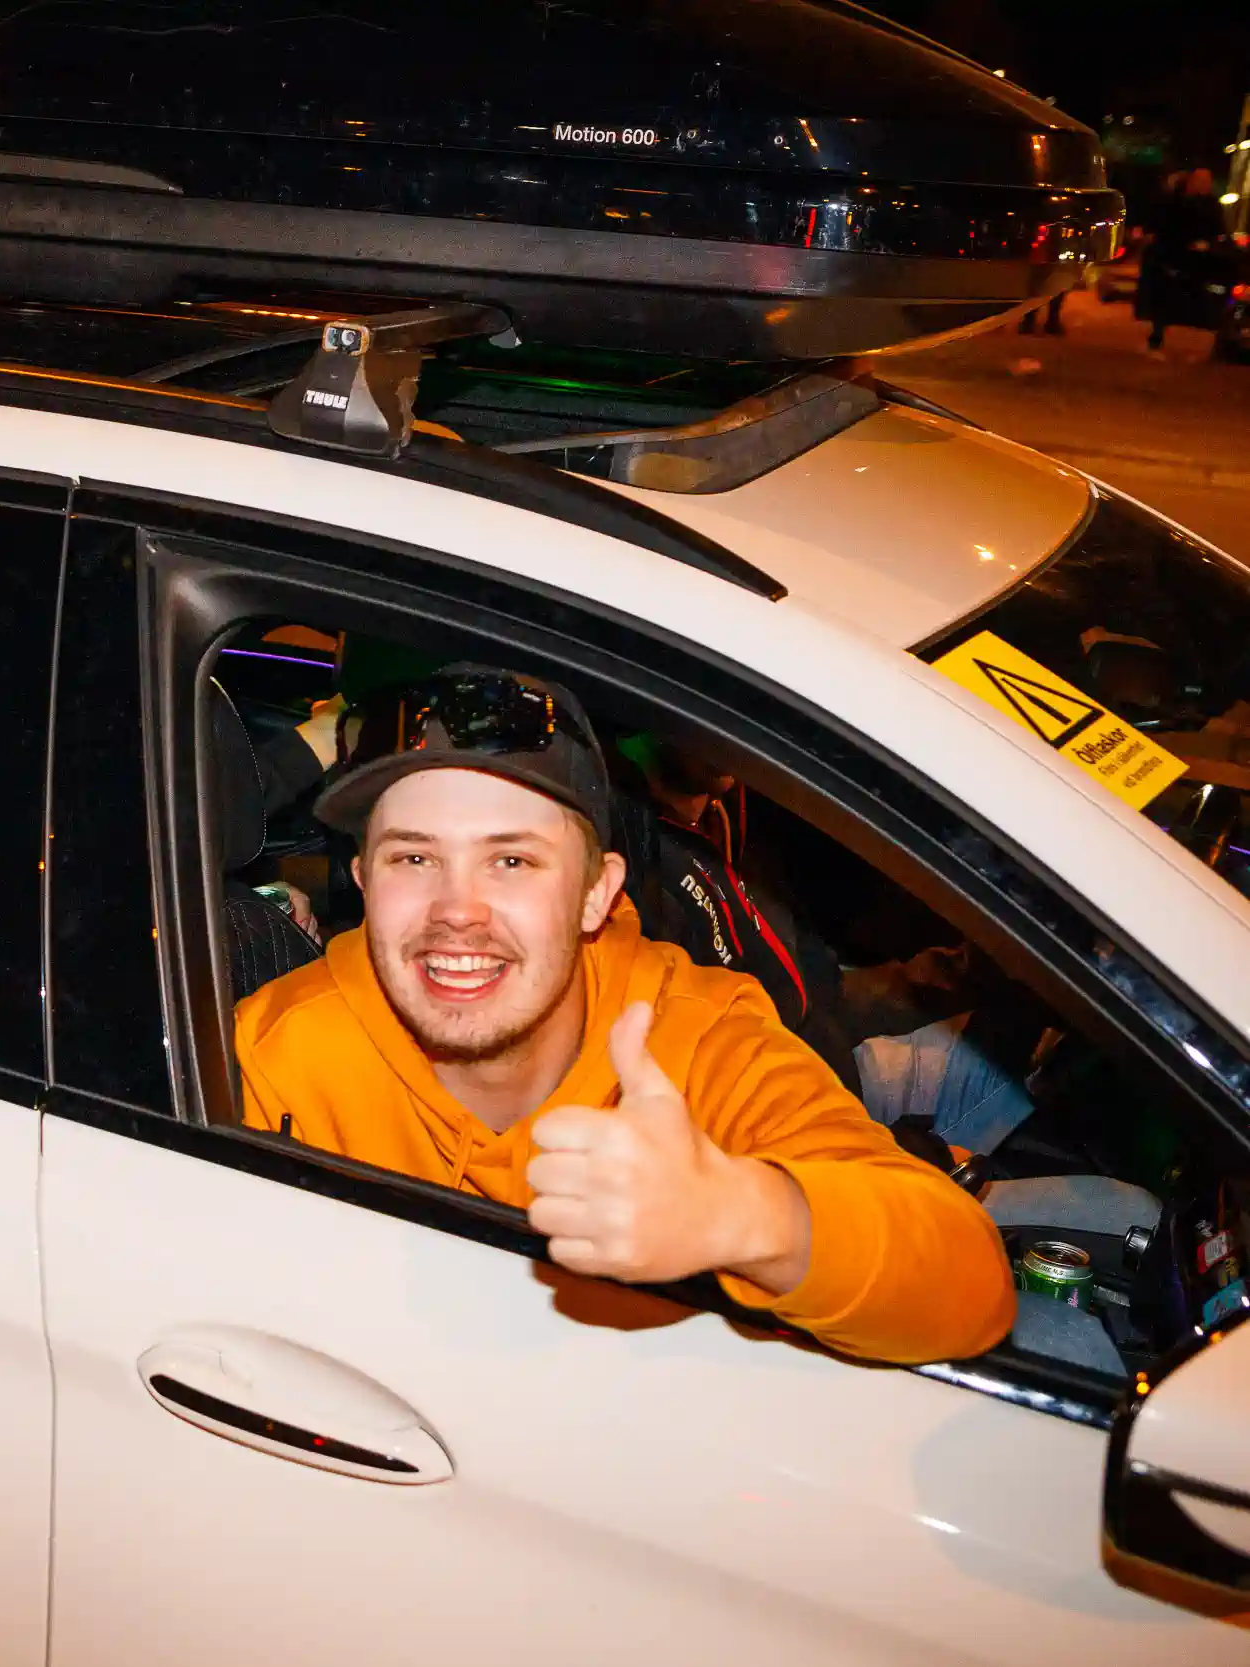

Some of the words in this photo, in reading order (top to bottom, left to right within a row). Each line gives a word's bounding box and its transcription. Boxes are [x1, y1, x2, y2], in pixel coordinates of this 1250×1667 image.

[554, 124, 616, 143] Motion
[622, 129, 655, 145] 600
[305, 390, 349, 410] THULE
